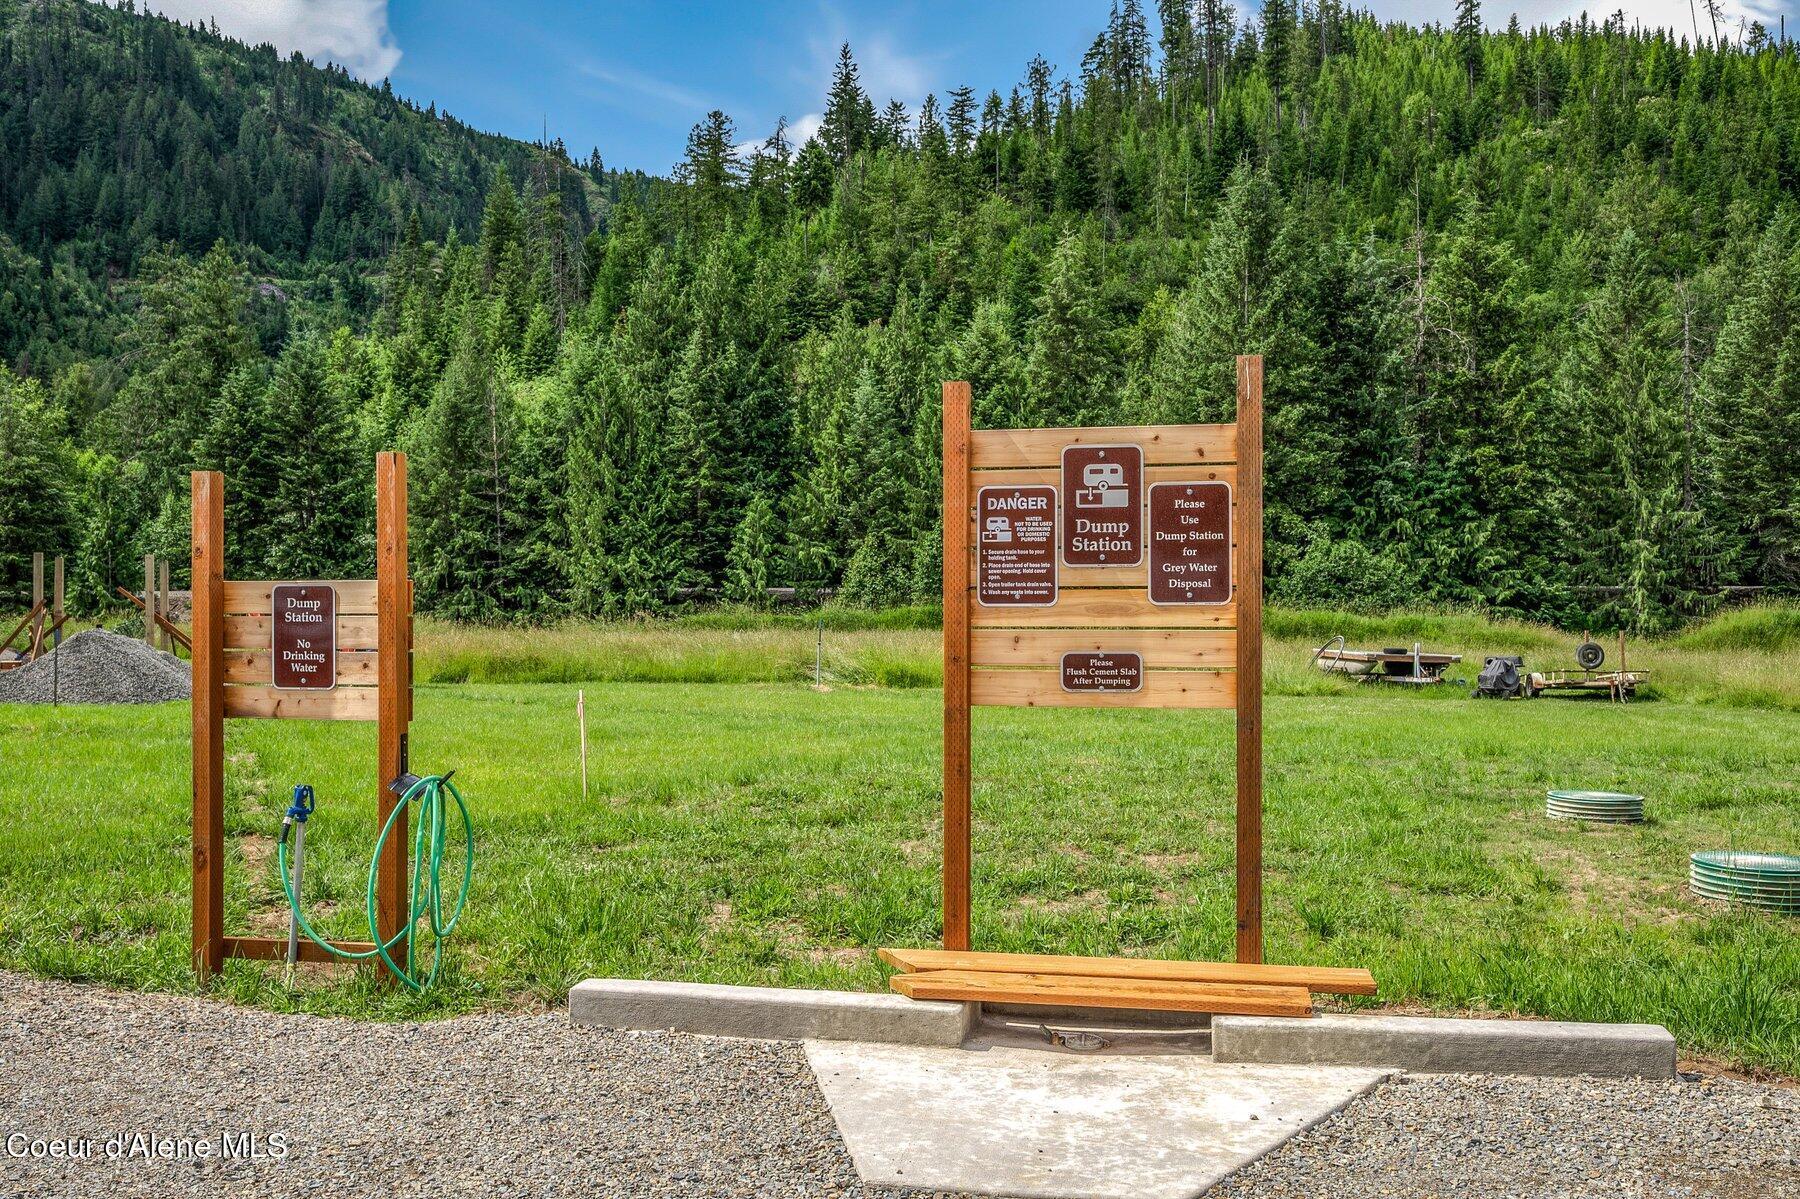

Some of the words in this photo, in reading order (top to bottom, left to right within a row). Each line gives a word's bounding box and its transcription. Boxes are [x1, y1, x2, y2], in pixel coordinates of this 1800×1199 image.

[987, 497, 1047, 510] DANGER
[1174, 499, 1206, 508] Please
[1180, 515, 1199, 524] Use
[1075, 519, 1130, 538] Dump
[1156, 531, 1187, 542] Dump
[1189, 531, 1224, 540] Station
[1072, 536, 1132, 551] Station
[1182, 547, 1197, 556] for
[1162, 563, 1187, 574] Grey
[1189, 563, 1218, 572] Water
[1168, 579, 1212, 590] Disposal
[286, 597, 321, 611] Dump
[284, 611, 323, 622] Station
[297, 639, 311, 648] No
[283, 650, 325, 663] Drinking
[1089, 658, 1114, 666] Please
[291, 663, 318, 672] Water
[1094, 677, 1131, 686] Dumping
